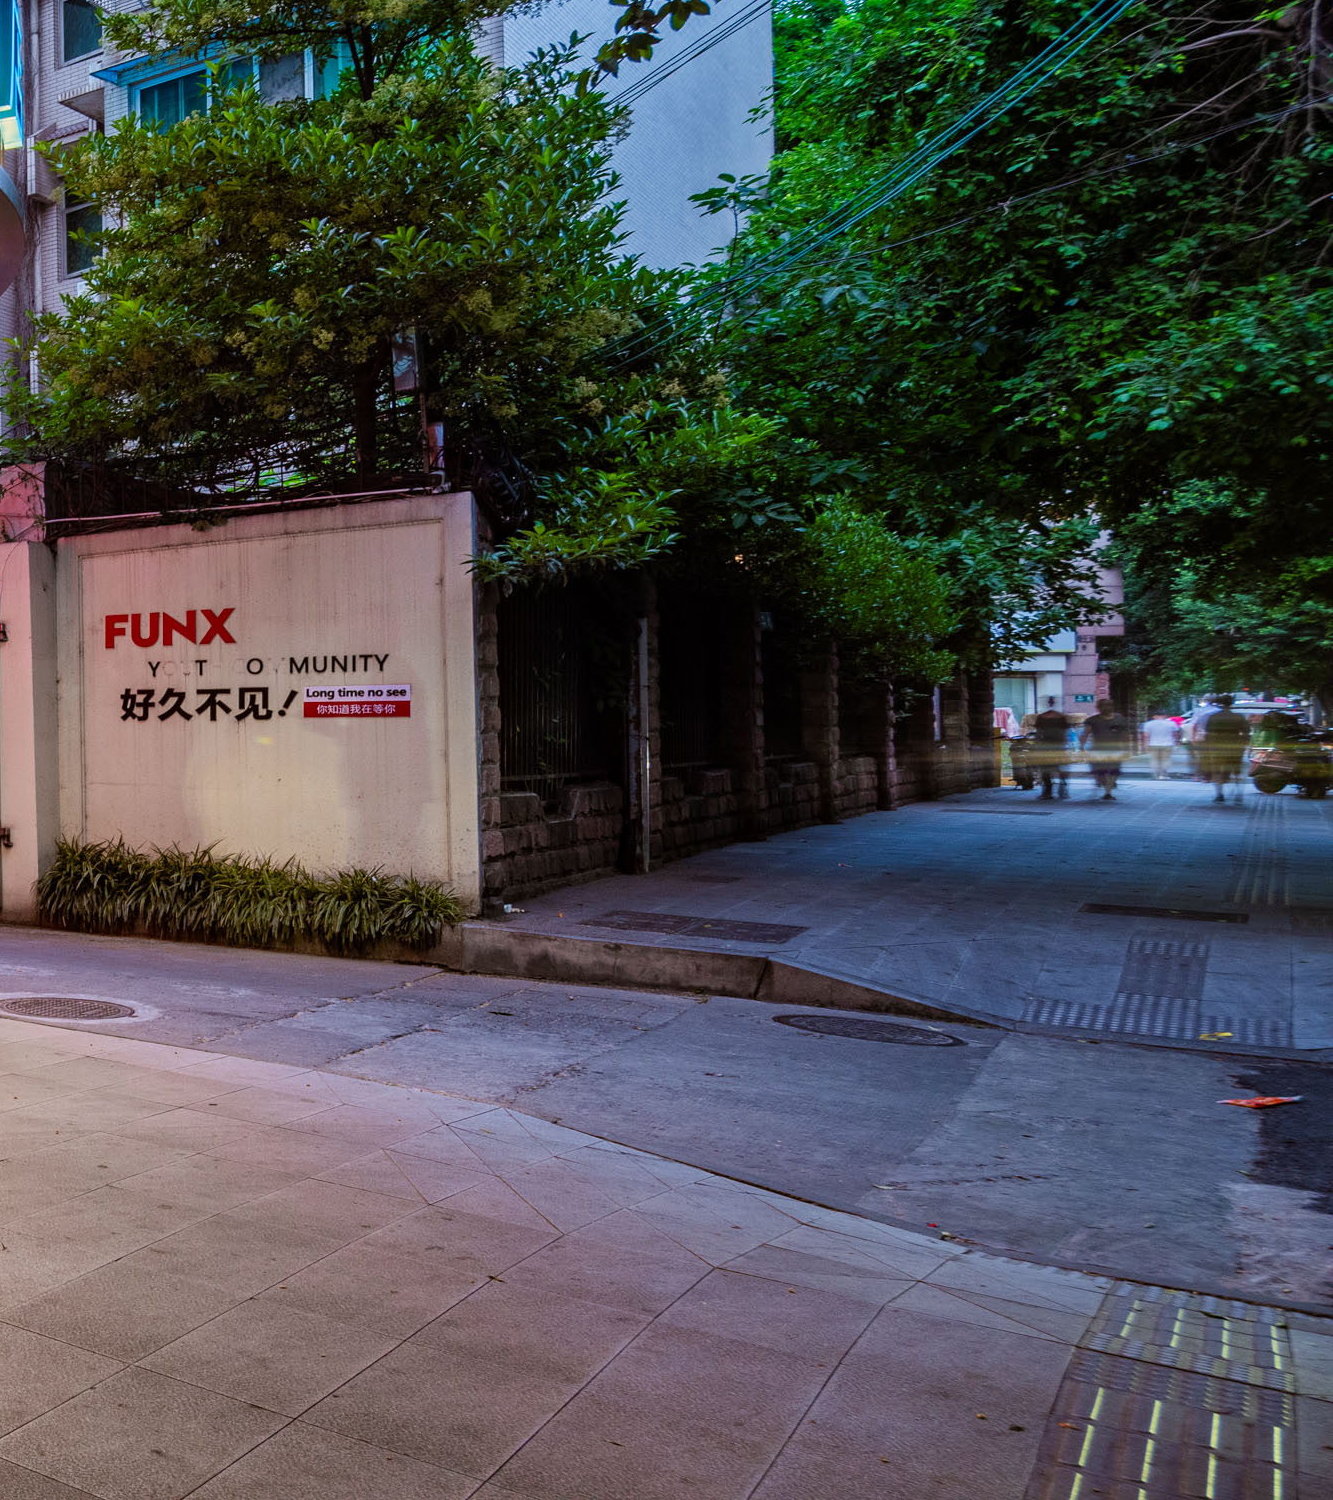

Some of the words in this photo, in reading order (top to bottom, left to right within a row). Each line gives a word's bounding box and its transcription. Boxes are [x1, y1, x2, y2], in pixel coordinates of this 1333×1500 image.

[105, 607, 237, 650] FUNX
[120, 687, 298, 722] 好久不见！
[306, 688, 335, 700] Long
[338, 687, 365, 698] time
[367, 689, 384, 698] no
[386, 688, 407, 697] see
[316, 703, 397, 716] 你知道我在等你
